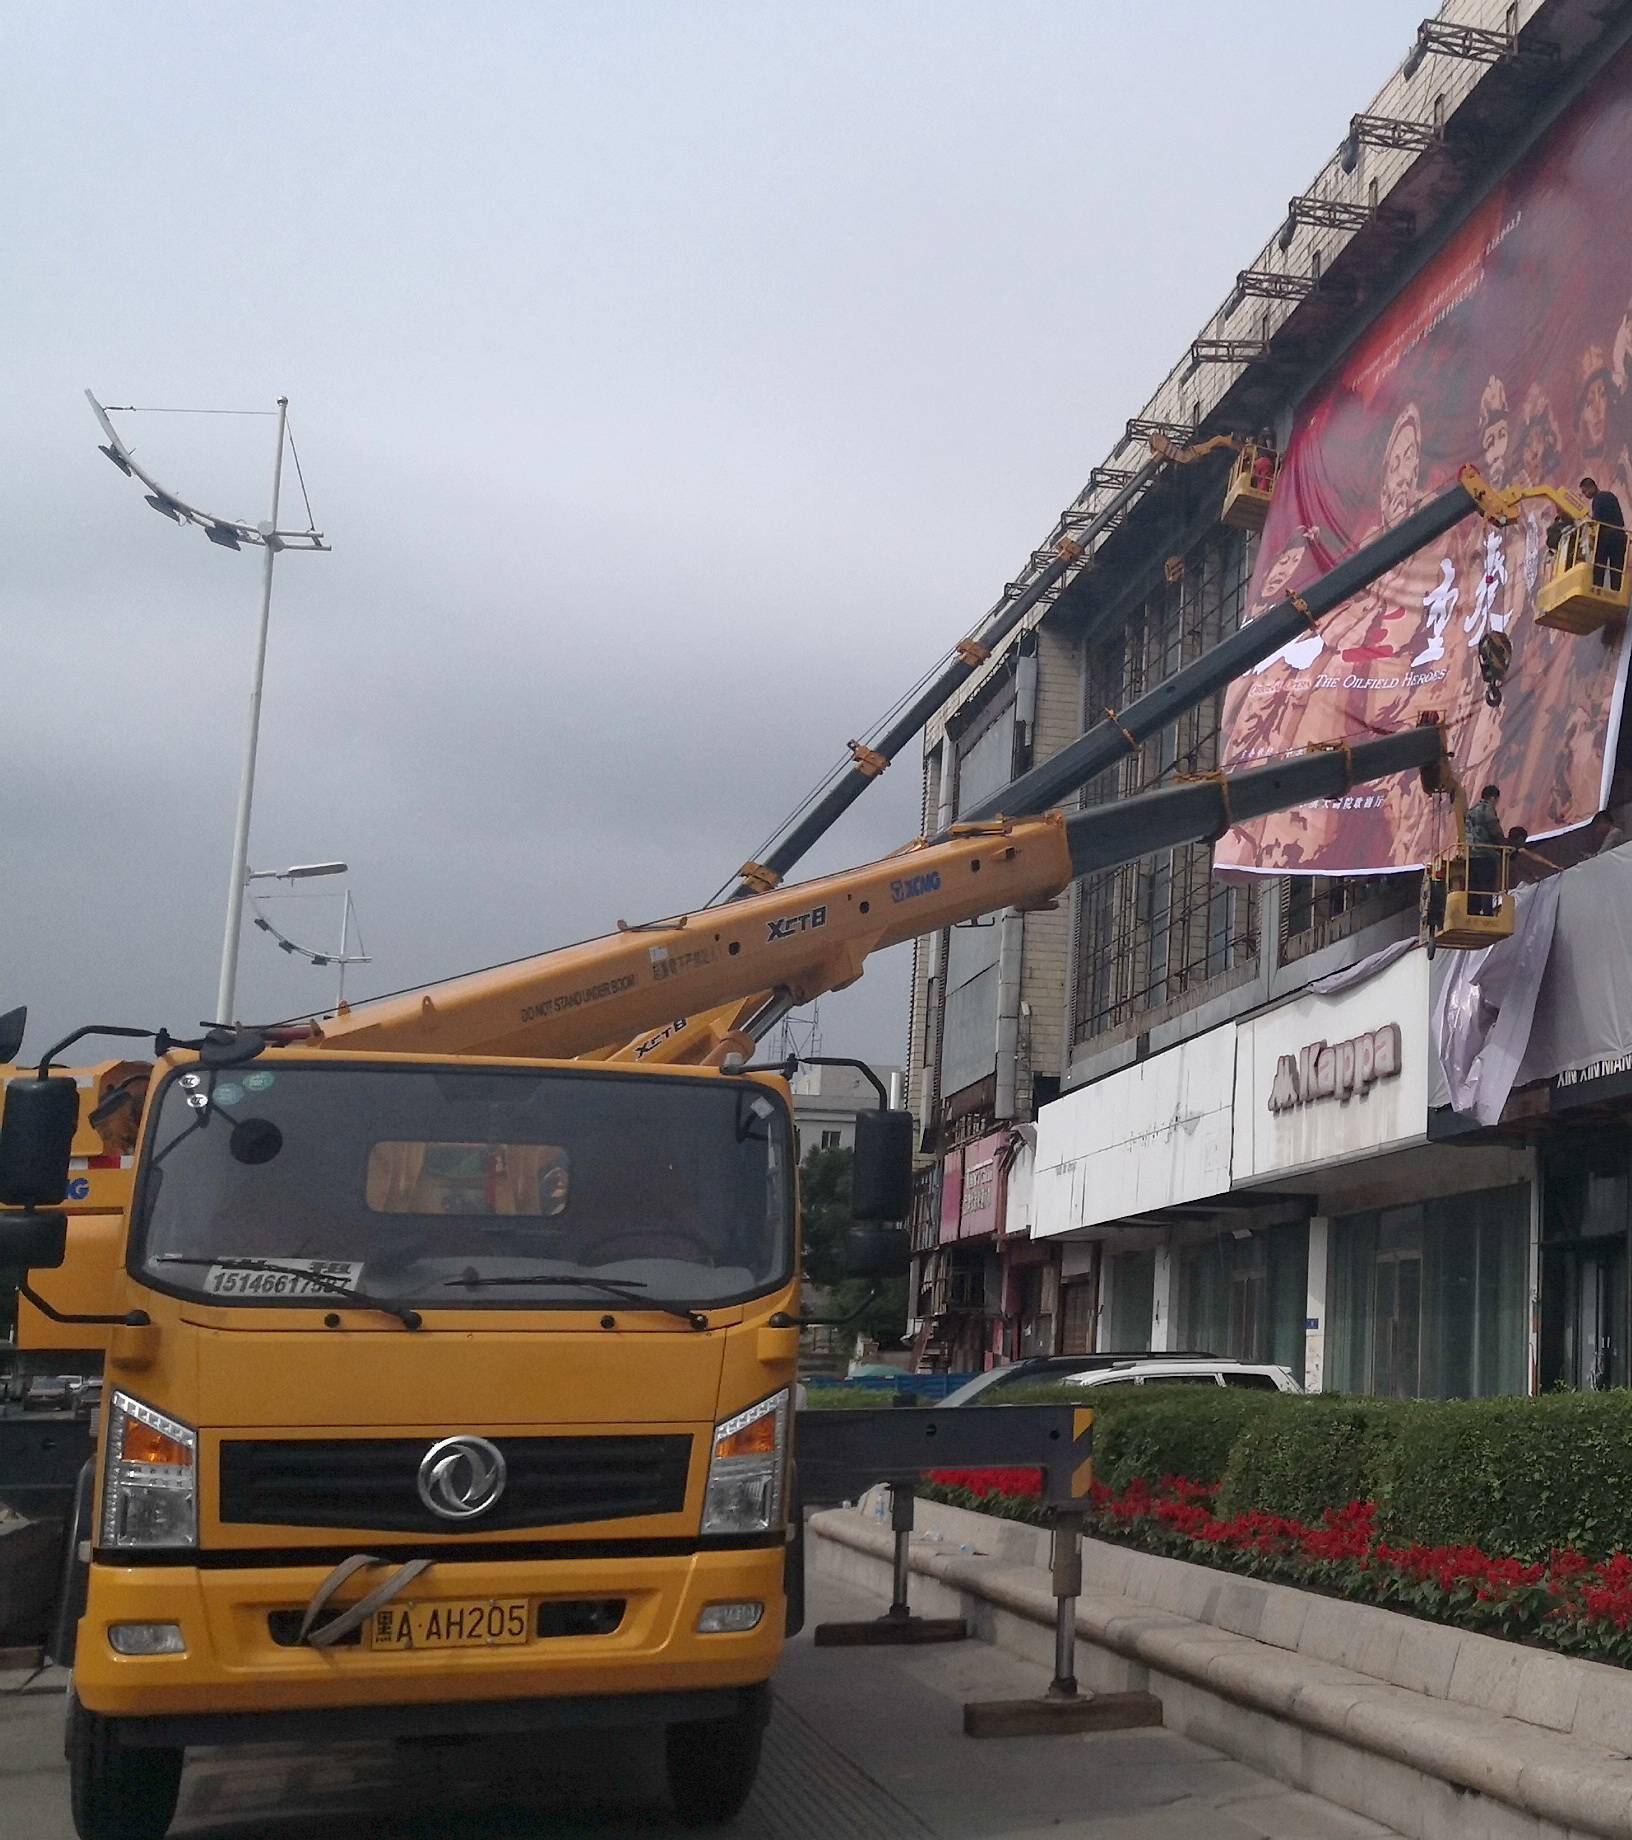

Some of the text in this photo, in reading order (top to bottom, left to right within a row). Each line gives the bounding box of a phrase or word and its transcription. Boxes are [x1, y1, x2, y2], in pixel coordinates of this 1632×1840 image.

[1315, 674, 1340, 689] THE
[1343, 675, 1399, 689] OILFIELD
[1402, 669, 1447, 687] HEROES
[767, 904, 827, 942] XCT8
[1299, 1022, 1402, 1106] Kappa
